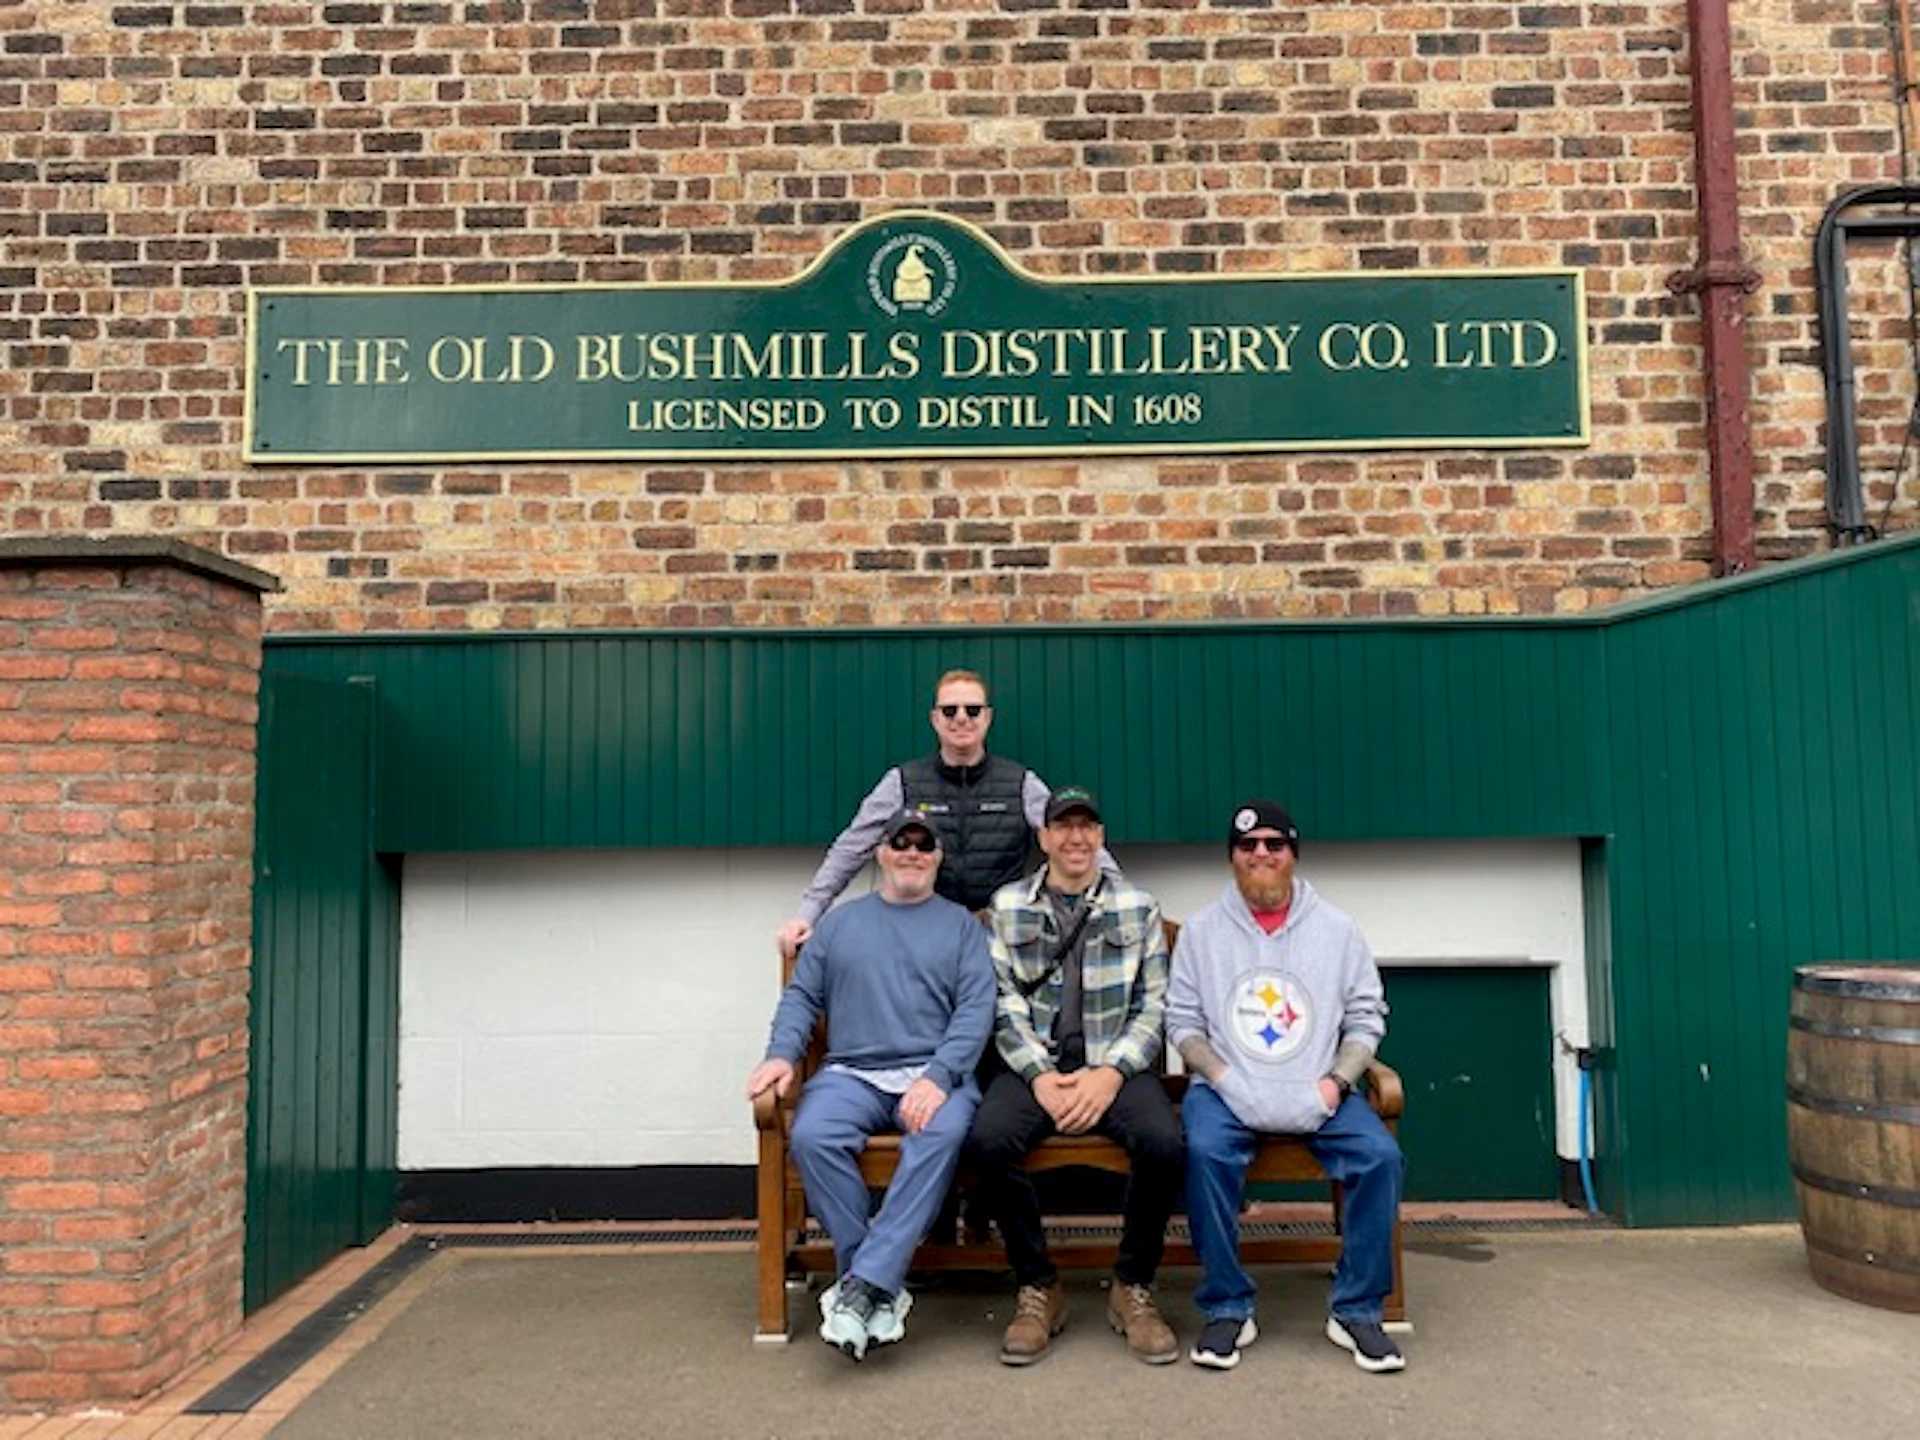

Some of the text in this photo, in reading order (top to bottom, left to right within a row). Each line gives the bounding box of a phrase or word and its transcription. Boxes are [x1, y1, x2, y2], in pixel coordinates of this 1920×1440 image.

[277, 320, 1557, 385] THE OLD BUSHMILLS DISTILLERY CO. LTD
[628, 392, 1202, 431] LICENSED TO DISTIL IN 1608
